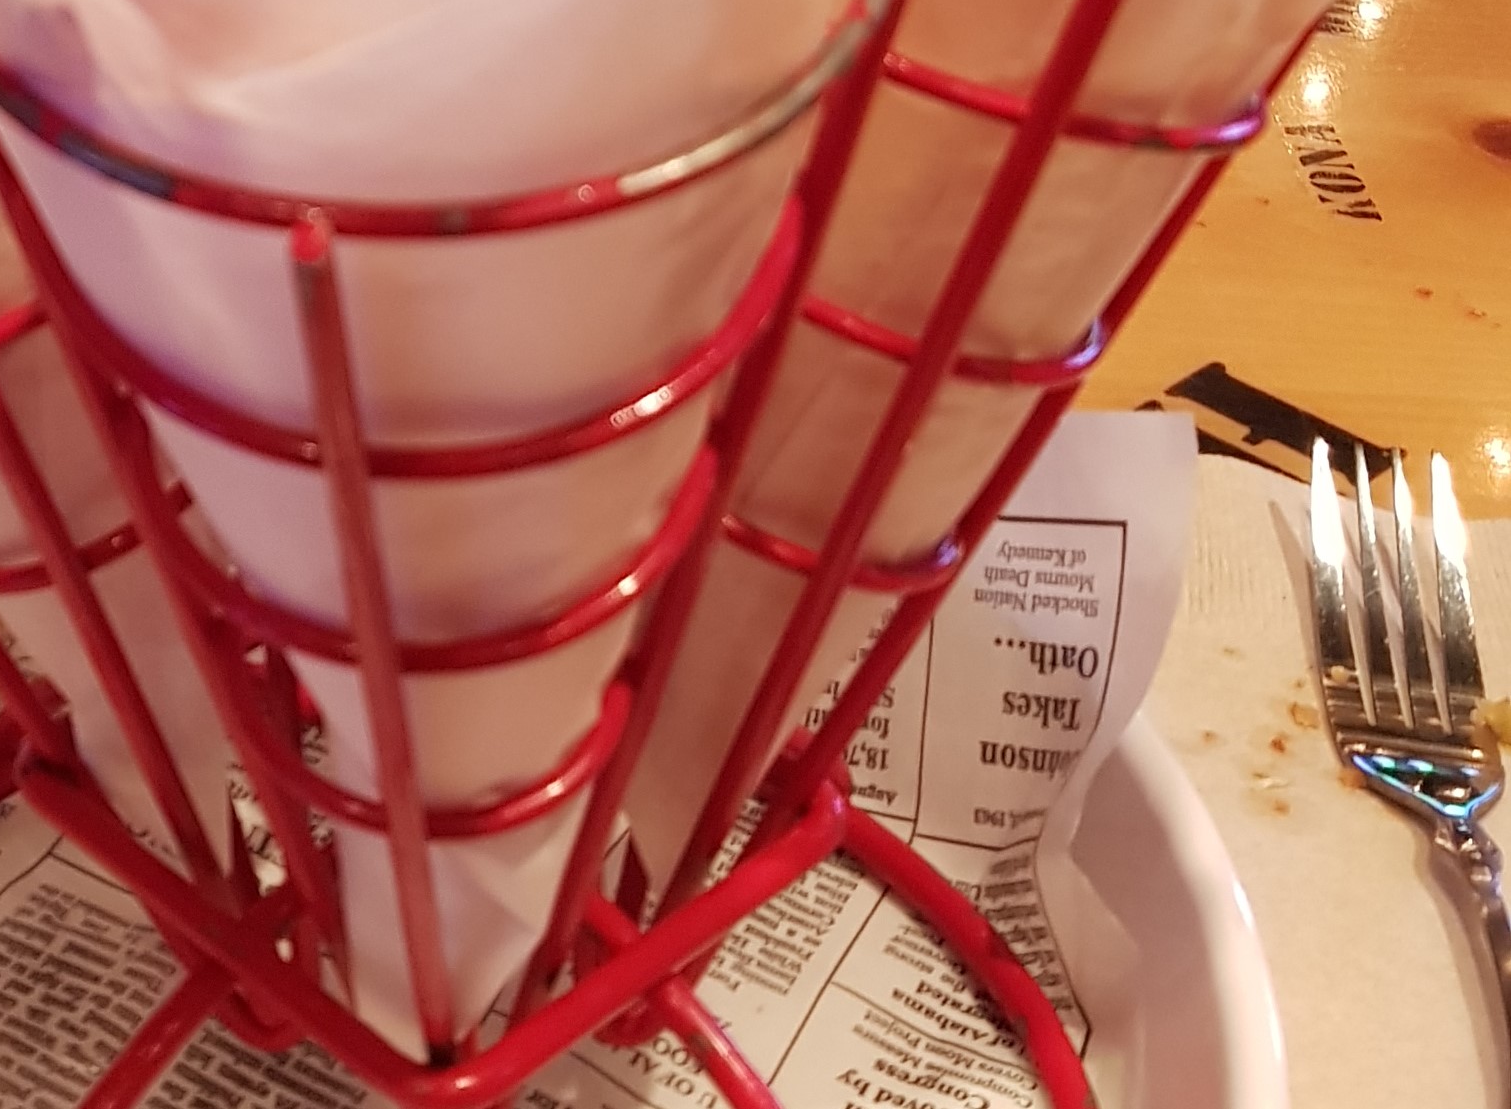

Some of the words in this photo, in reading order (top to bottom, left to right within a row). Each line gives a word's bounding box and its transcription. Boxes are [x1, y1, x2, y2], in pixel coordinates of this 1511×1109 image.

[998, 541, 1064, 566] Kennedy
[1068, 550, 1086, 566] of
[984, 567, 1029, 588] Death
[1035, 571, 1093, 592] Mourns
[974, 589, 1026, 611] Nation
[1031, 594, 1098, 617] Shocked
[1003, 692, 1079, 730] Takes
[893, 990, 986, 1040] Alabama
[864, 1011, 921, 1047] Project
[925, 1039, 974, 1069] Moon
[838, 1070, 870, 1096] by
[875, 1060, 989, 1109] Congress
